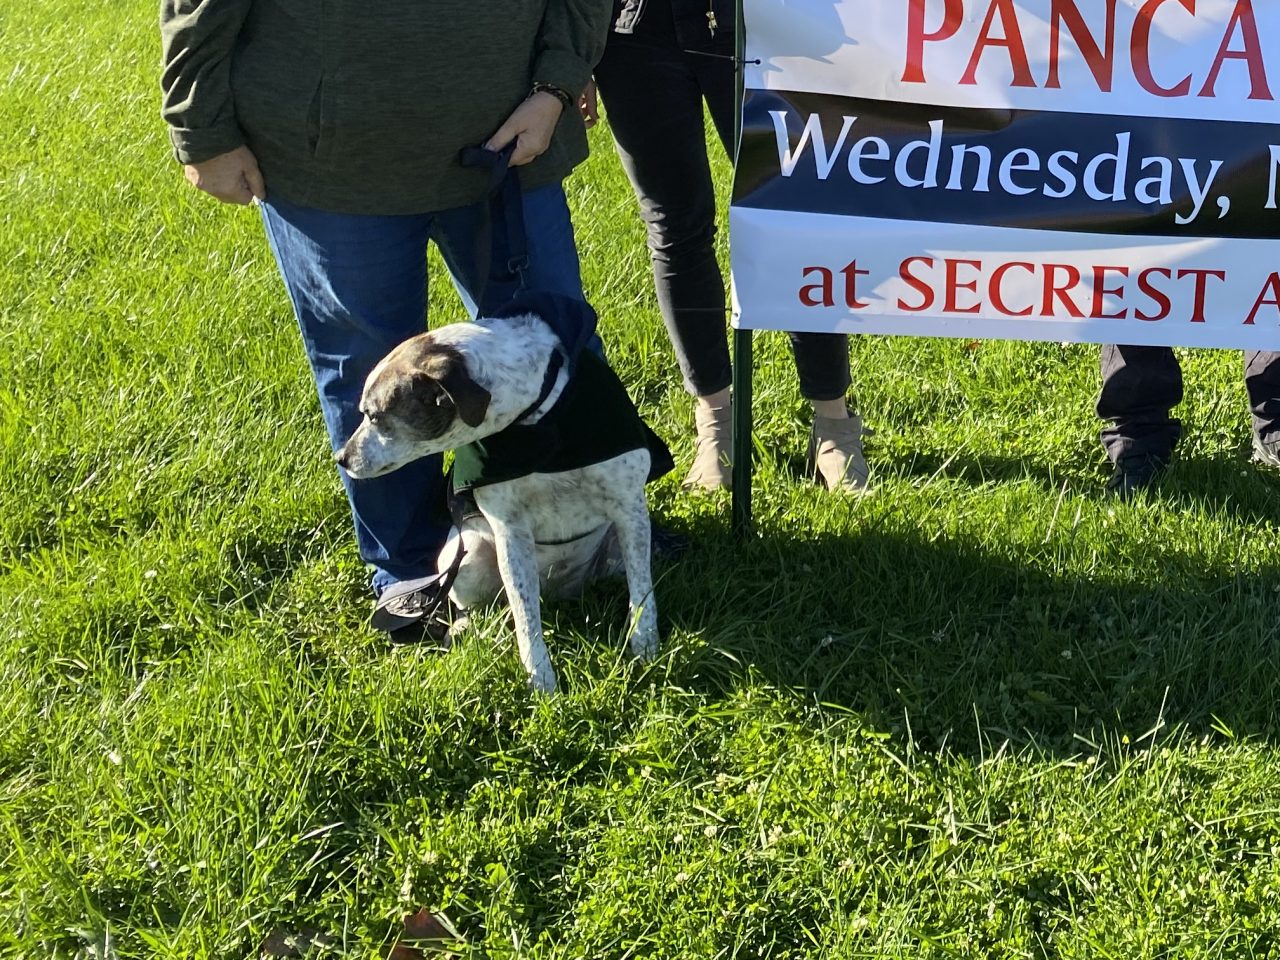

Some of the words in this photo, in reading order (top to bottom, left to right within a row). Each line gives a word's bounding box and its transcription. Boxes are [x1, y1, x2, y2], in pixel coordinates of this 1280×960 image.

[767, 110, 1231, 225] Wednesday,
[798, 258, 870, 309] at
[897, 256, 1226, 323] SECREST
